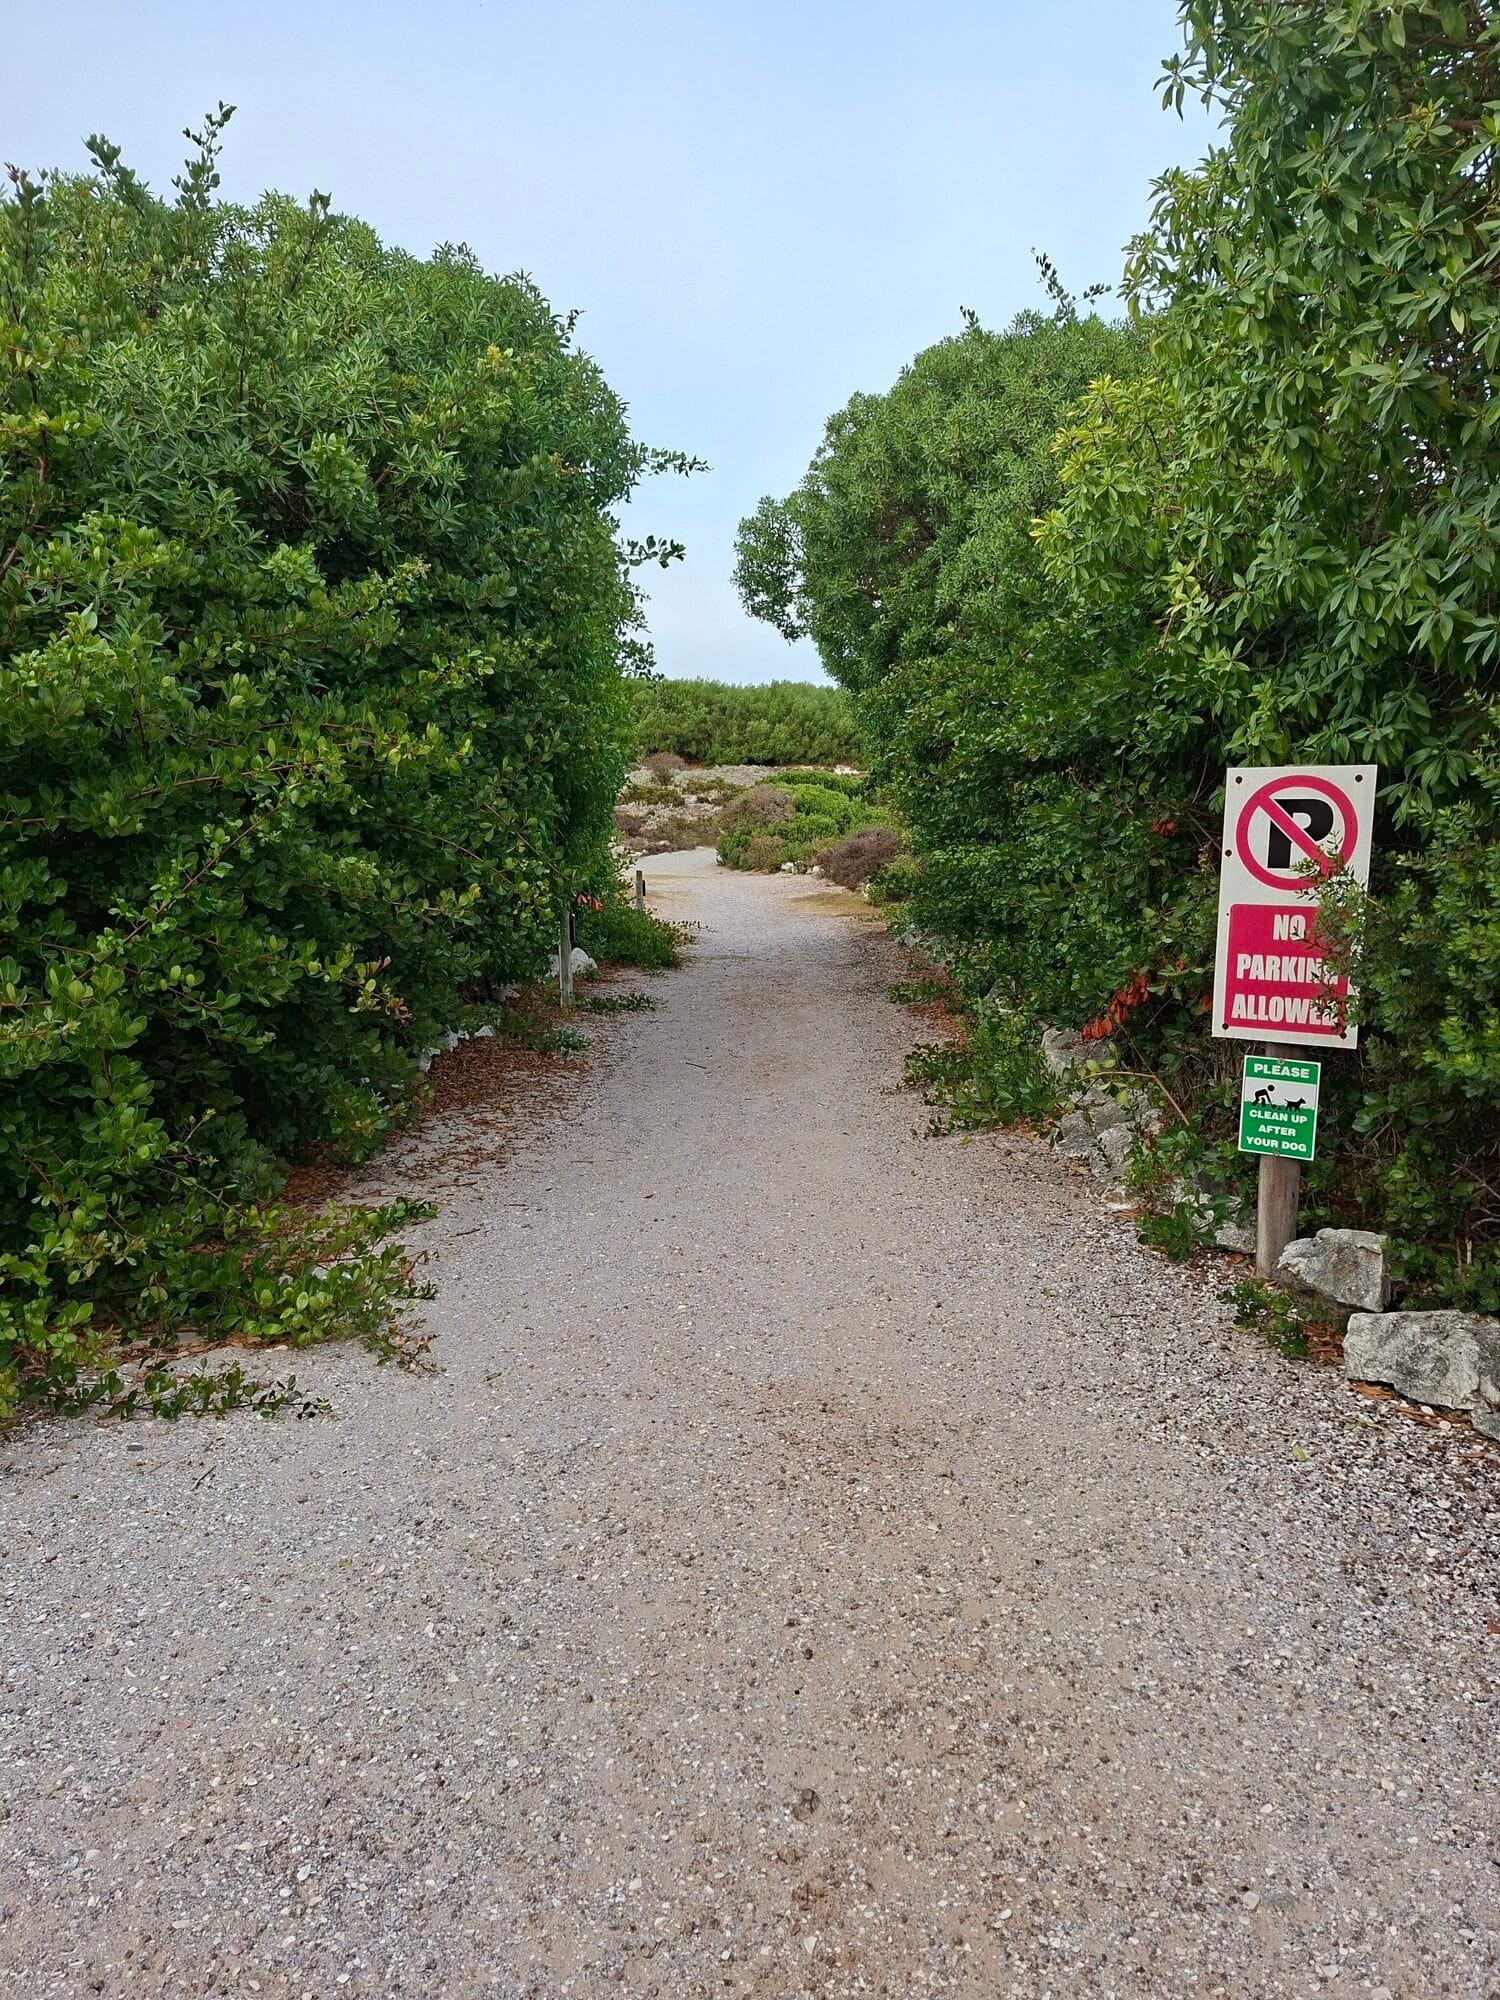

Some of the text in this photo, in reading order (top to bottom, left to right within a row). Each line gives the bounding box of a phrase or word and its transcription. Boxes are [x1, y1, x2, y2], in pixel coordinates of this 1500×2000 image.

[1273, 914, 1306, 941] NO
[1253, 1063, 1310, 1079] PLEASE
[1249, 1109, 1308, 1124] CLEAN UP
[1258, 1124, 1296, 1137] AFTER
[1246, 1136, 1307, 1152] YOUR DOG
